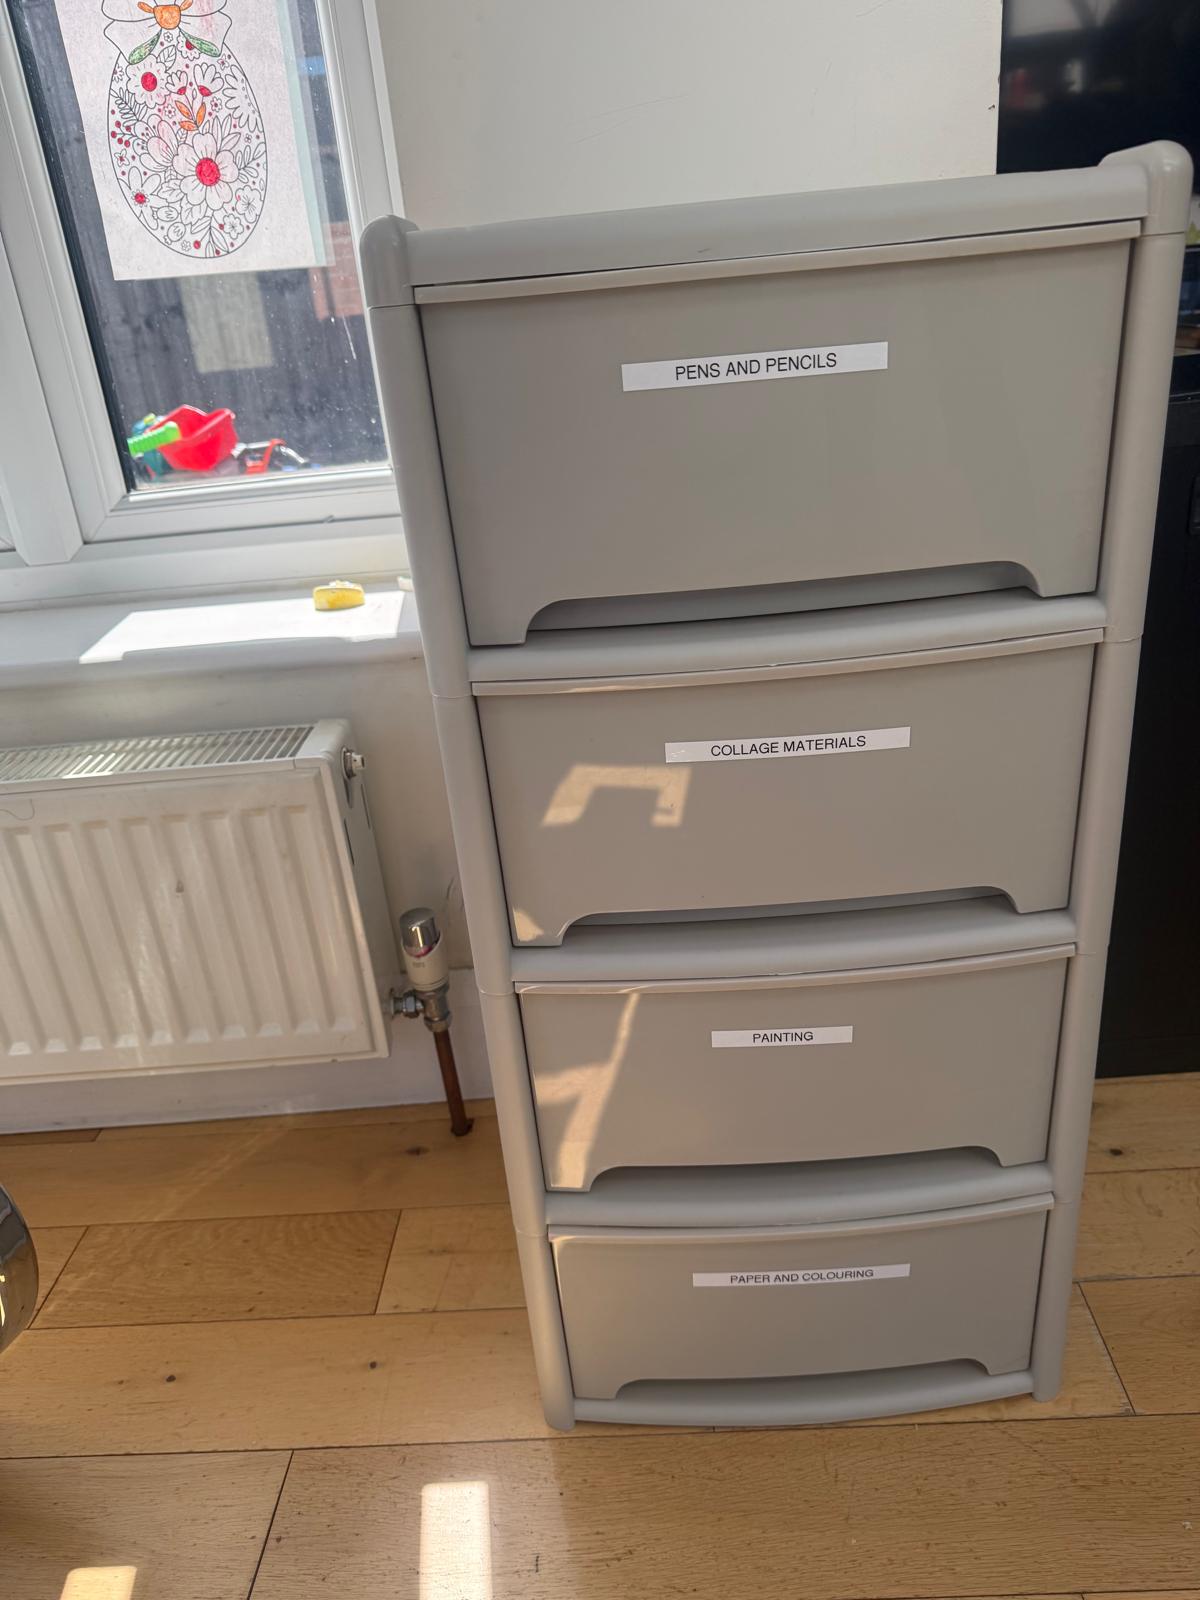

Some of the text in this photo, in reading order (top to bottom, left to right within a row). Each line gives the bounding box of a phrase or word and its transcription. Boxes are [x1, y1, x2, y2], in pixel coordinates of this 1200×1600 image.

[675, 352, 838, 381] PENS AND PENCILS
[710, 735, 867, 757] COLLAGE MATERIALS
[752, 1031, 814, 1043] PAINTING
[730, 1269, 874, 1284] PAPER AND COLOURING
